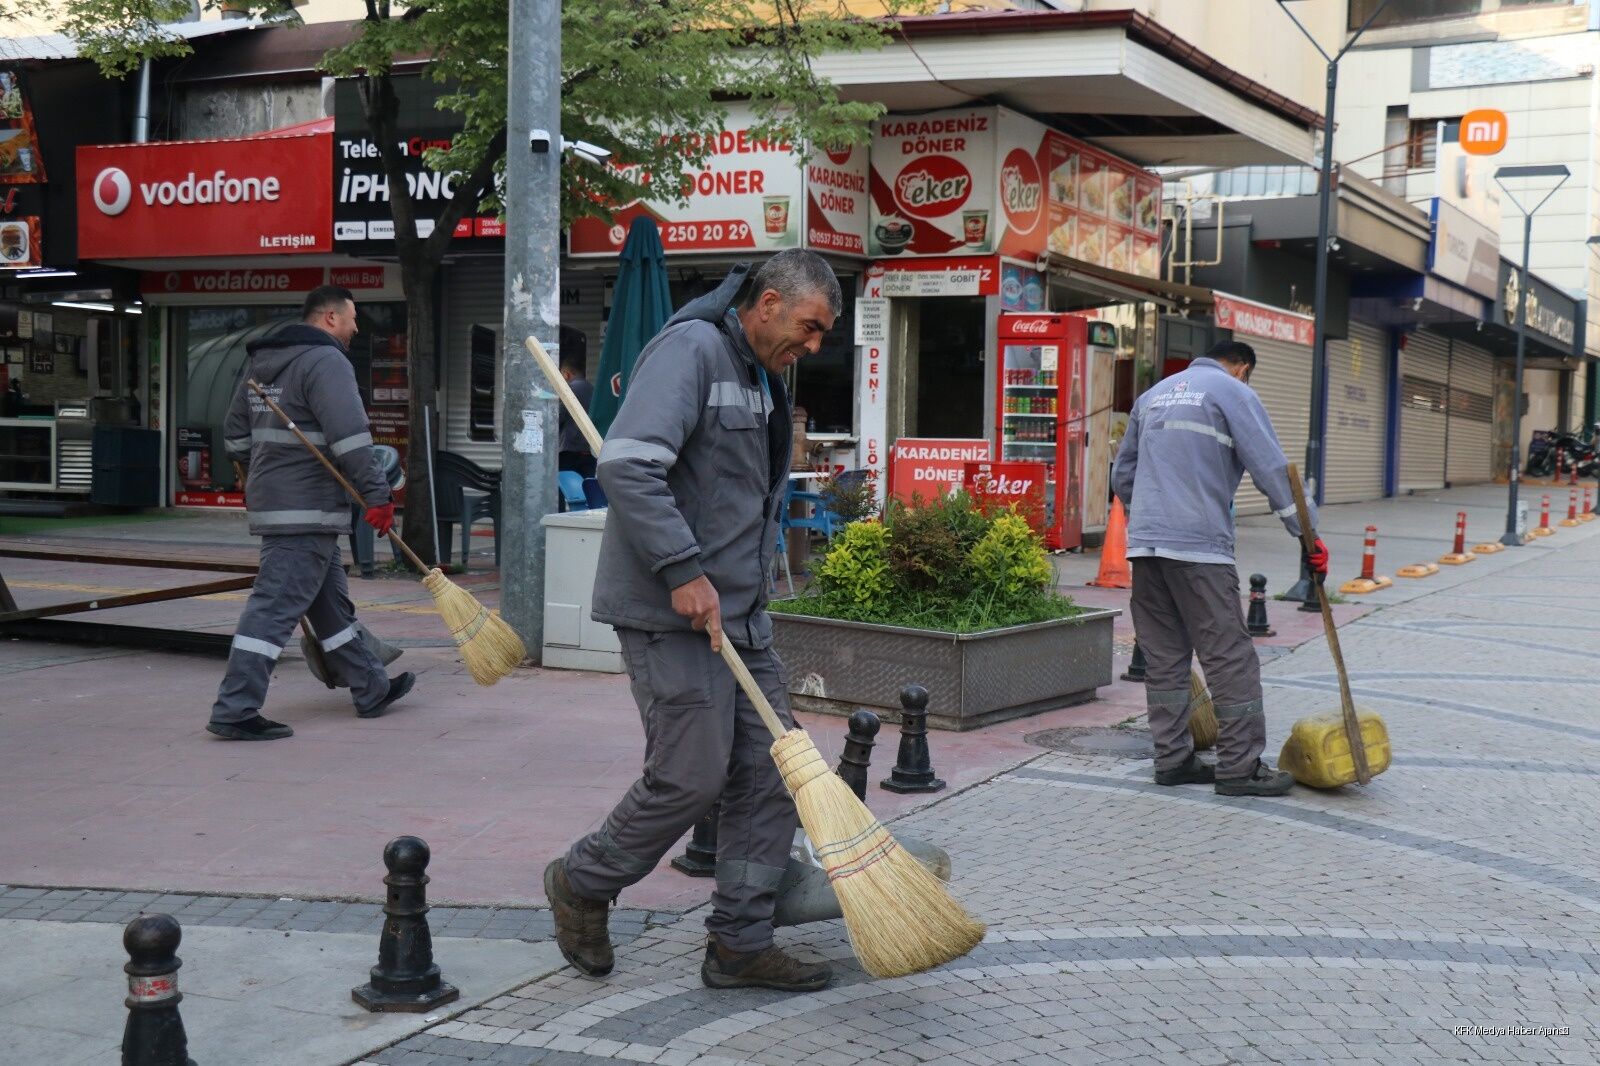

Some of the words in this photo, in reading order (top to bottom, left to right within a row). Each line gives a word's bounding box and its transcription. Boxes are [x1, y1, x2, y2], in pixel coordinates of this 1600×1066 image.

[880, 113, 988, 138] KARADENİZ
[901, 136, 966, 155] DÖNER
[140, 170, 281, 206] vodafone
[680, 164, 764, 197] DÖNER
[809, 166, 865, 194] KARADENİZ
[912, 177, 967, 205] eker
[1009, 175, 1040, 210] eker
[820, 189, 854, 215] DÖNER
[260, 235, 316, 248] İLETİŞİM
[668, 226, 698, 242] 250
[703, 224, 723, 241] 20
[728, 223, 750, 240] 29
[817, 231, 830, 244] 0537
[193, 271, 290, 291] vodafone
[330, 272, 359, 285] Yetkili
[361, 271, 384, 286] Bayi
[885, 284, 911, 292] DÖNER
[897, 445, 988, 461] KARADENİZ
[986, 473, 1032, 495] eker
